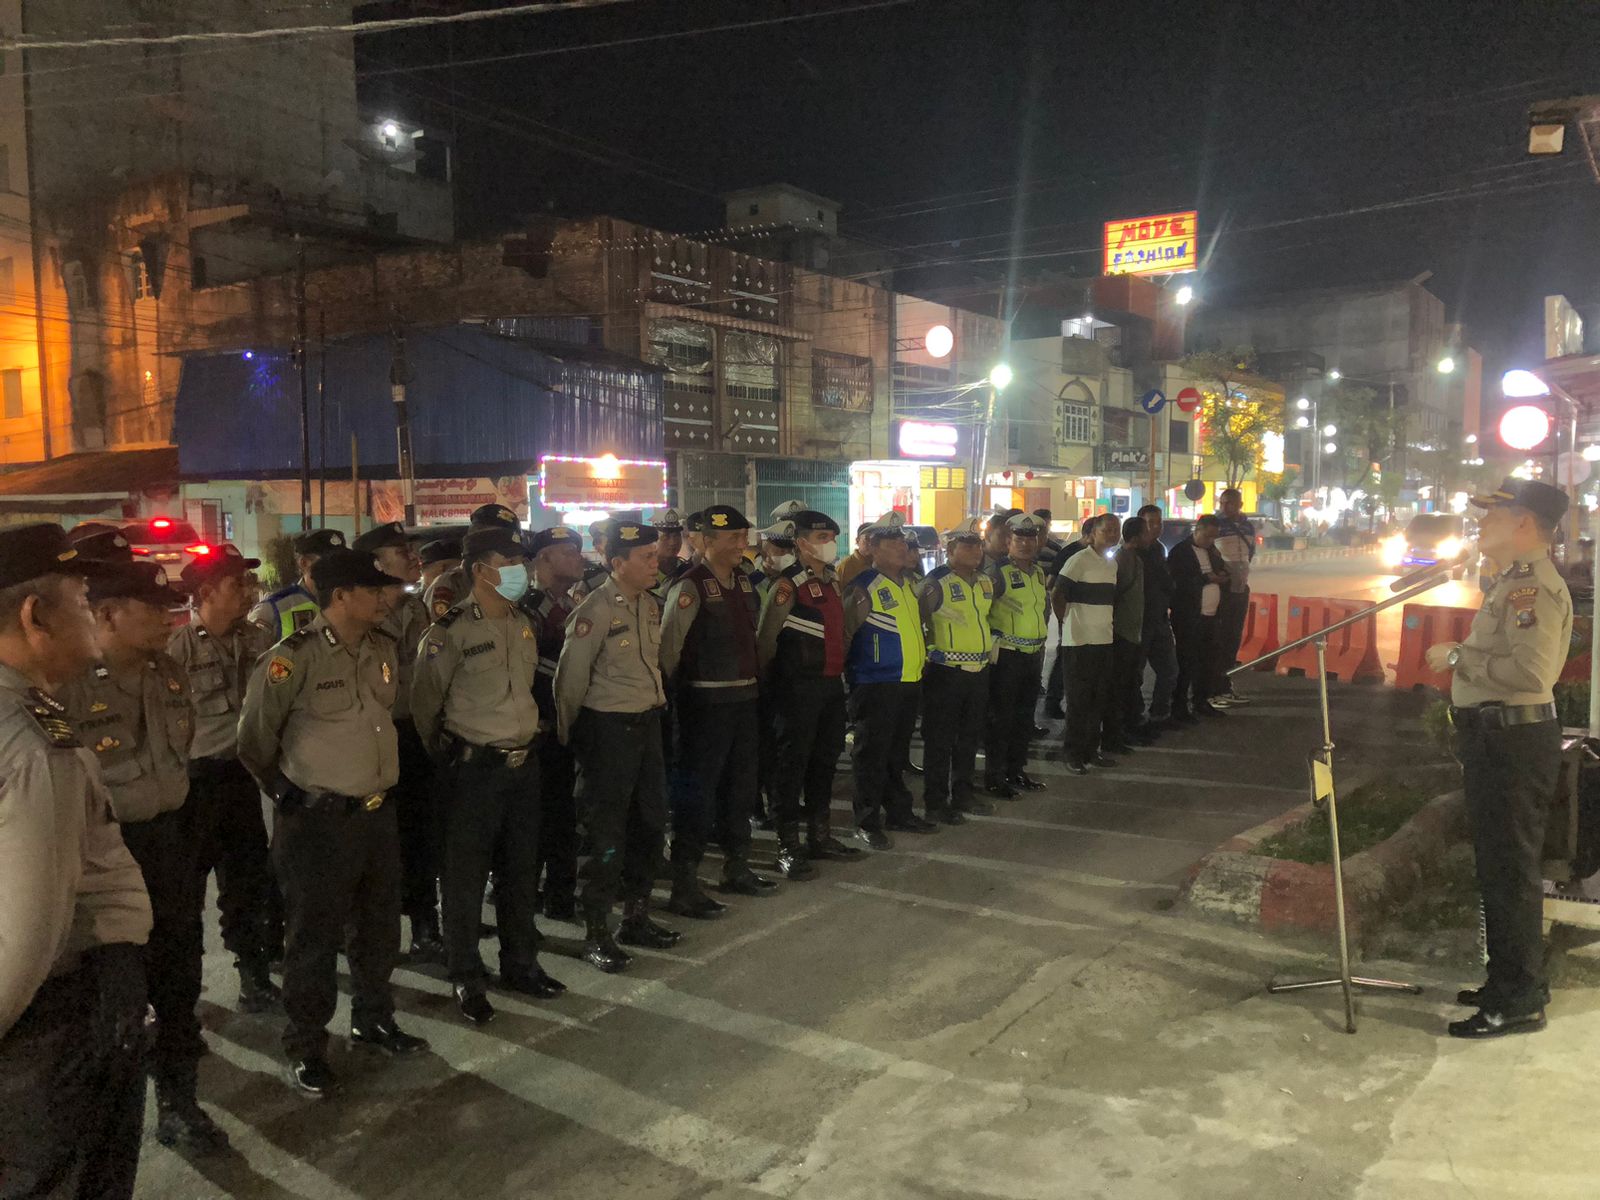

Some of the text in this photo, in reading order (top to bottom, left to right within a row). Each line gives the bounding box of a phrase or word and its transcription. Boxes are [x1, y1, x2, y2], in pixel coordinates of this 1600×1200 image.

[1117, 217, 1186, 249] MODE
[1113, 241, 1188, 270] FASHION
[1111, 451, 1147, 463] Pink's
